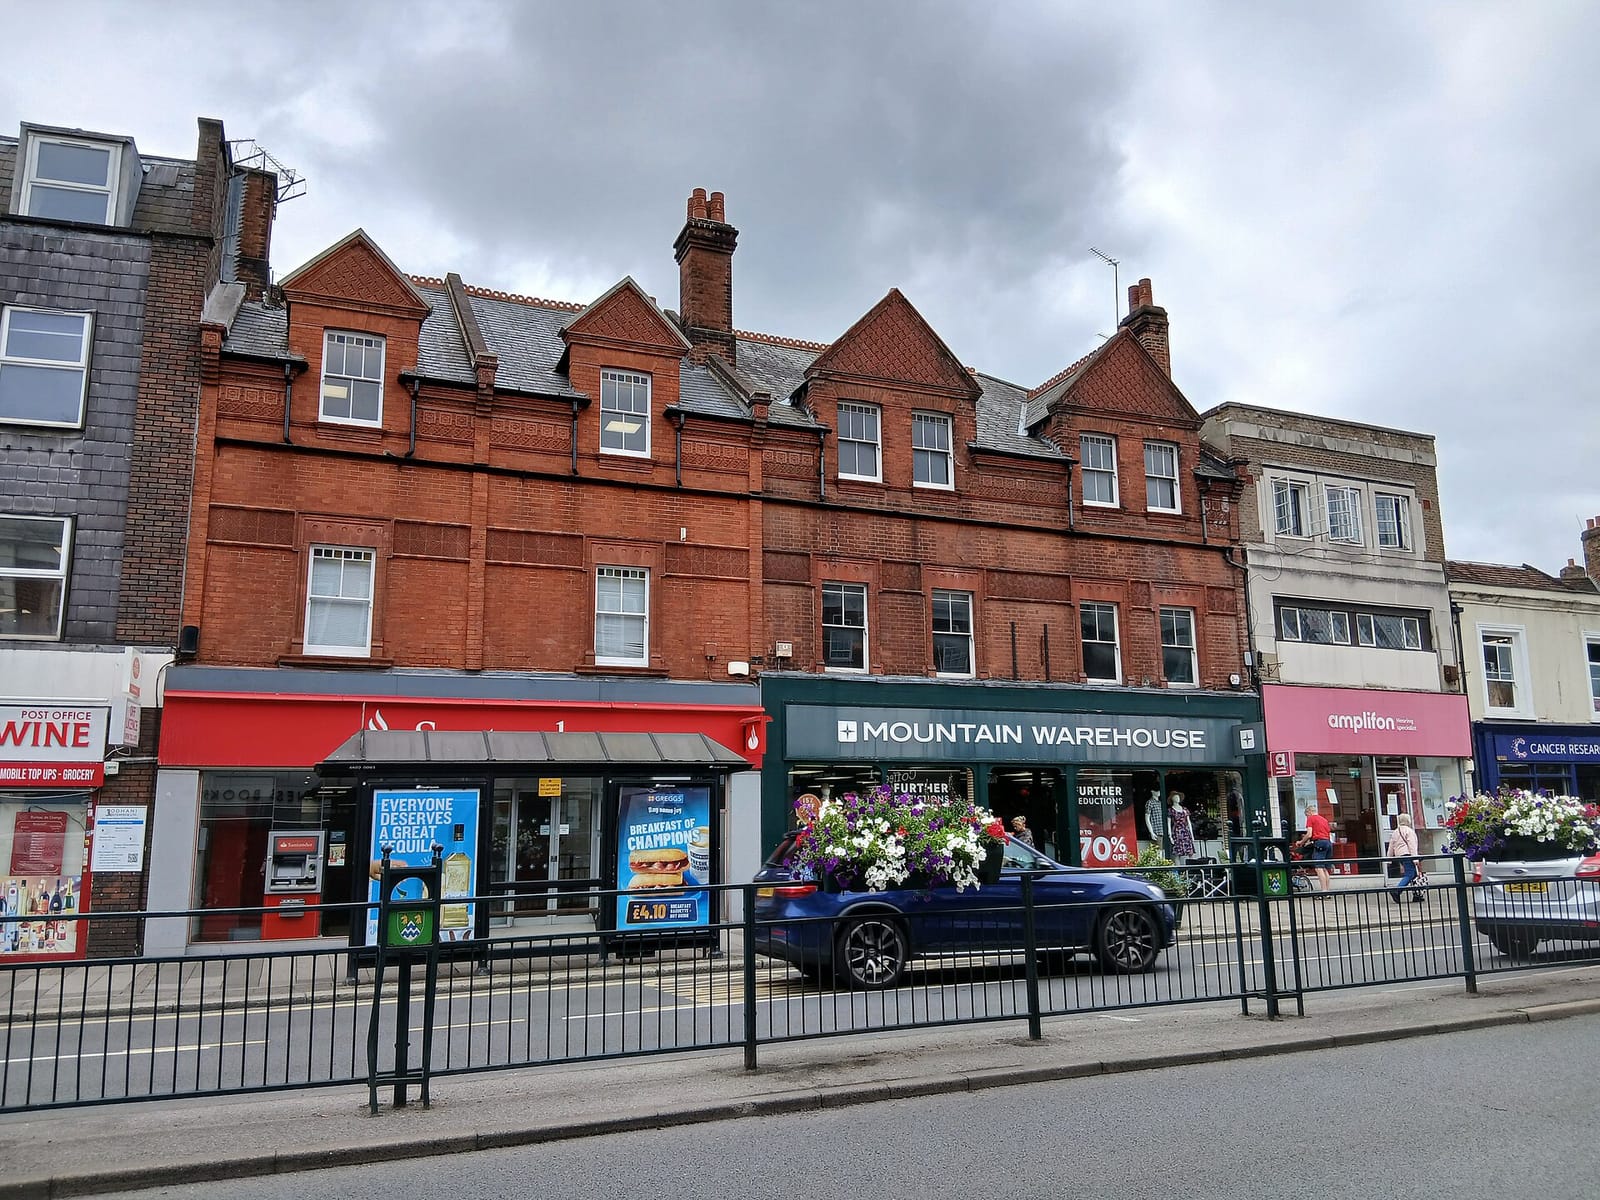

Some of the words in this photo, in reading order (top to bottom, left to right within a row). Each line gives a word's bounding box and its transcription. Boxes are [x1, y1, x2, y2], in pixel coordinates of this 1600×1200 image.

[21, 710, 49, 719] POST
[52, 711, 92, 720] OFFICE
[1328, 711, 1395, 733] amplifon
[0, 720, 90, 747] WINE
[863, 721, 1022, 743] MOUNTAIN
[1032, 726, 1206, 748] WAREHOUSE
[1530, 743, 1567, 754] CANCER
[1568, 744, 1600, 755] RESEAR
[0, 767, 26, 779] MOBILE
[28, 768, 42, 780] TOP
[43, 768, 57, 780] UPS
[63, 769, 95, 780] GROCERY
[893, 783, 949, 793] FURTHER
[1076, 786, 1122, 796] URTHER
[381, 797, 454, 812] EVERYONE
[655, 794, 683, 802] GREGGS
[1078, 797, 1123, 805] EDUCTIONS
[380, 811, 452, 826] DESERVES
[379, 826, 389, 840] A
[392, 825, 438, 839] GREAT
[629, 819, 682, 836] BREAKFAST
[684, 818, 696, 828] OF
[627, 829, 700, 851] CHAMPIONS
[633, 904, 667, 920] £4.10
